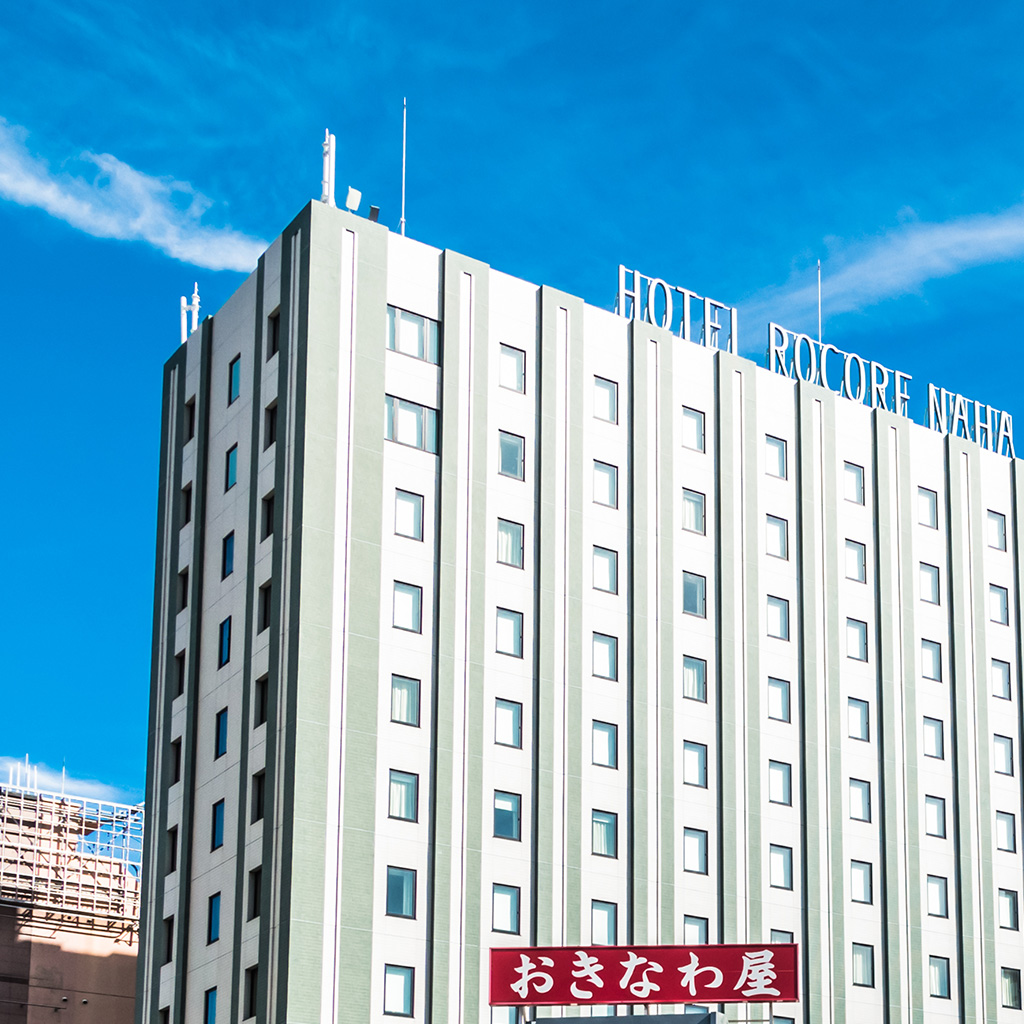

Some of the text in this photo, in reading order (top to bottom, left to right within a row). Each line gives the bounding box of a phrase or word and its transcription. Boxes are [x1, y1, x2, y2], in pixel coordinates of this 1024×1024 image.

[618, 264, 1016, 459] HOTEL ROCORE NAHA
[510, 950, 781, 999] おきなわ屋
